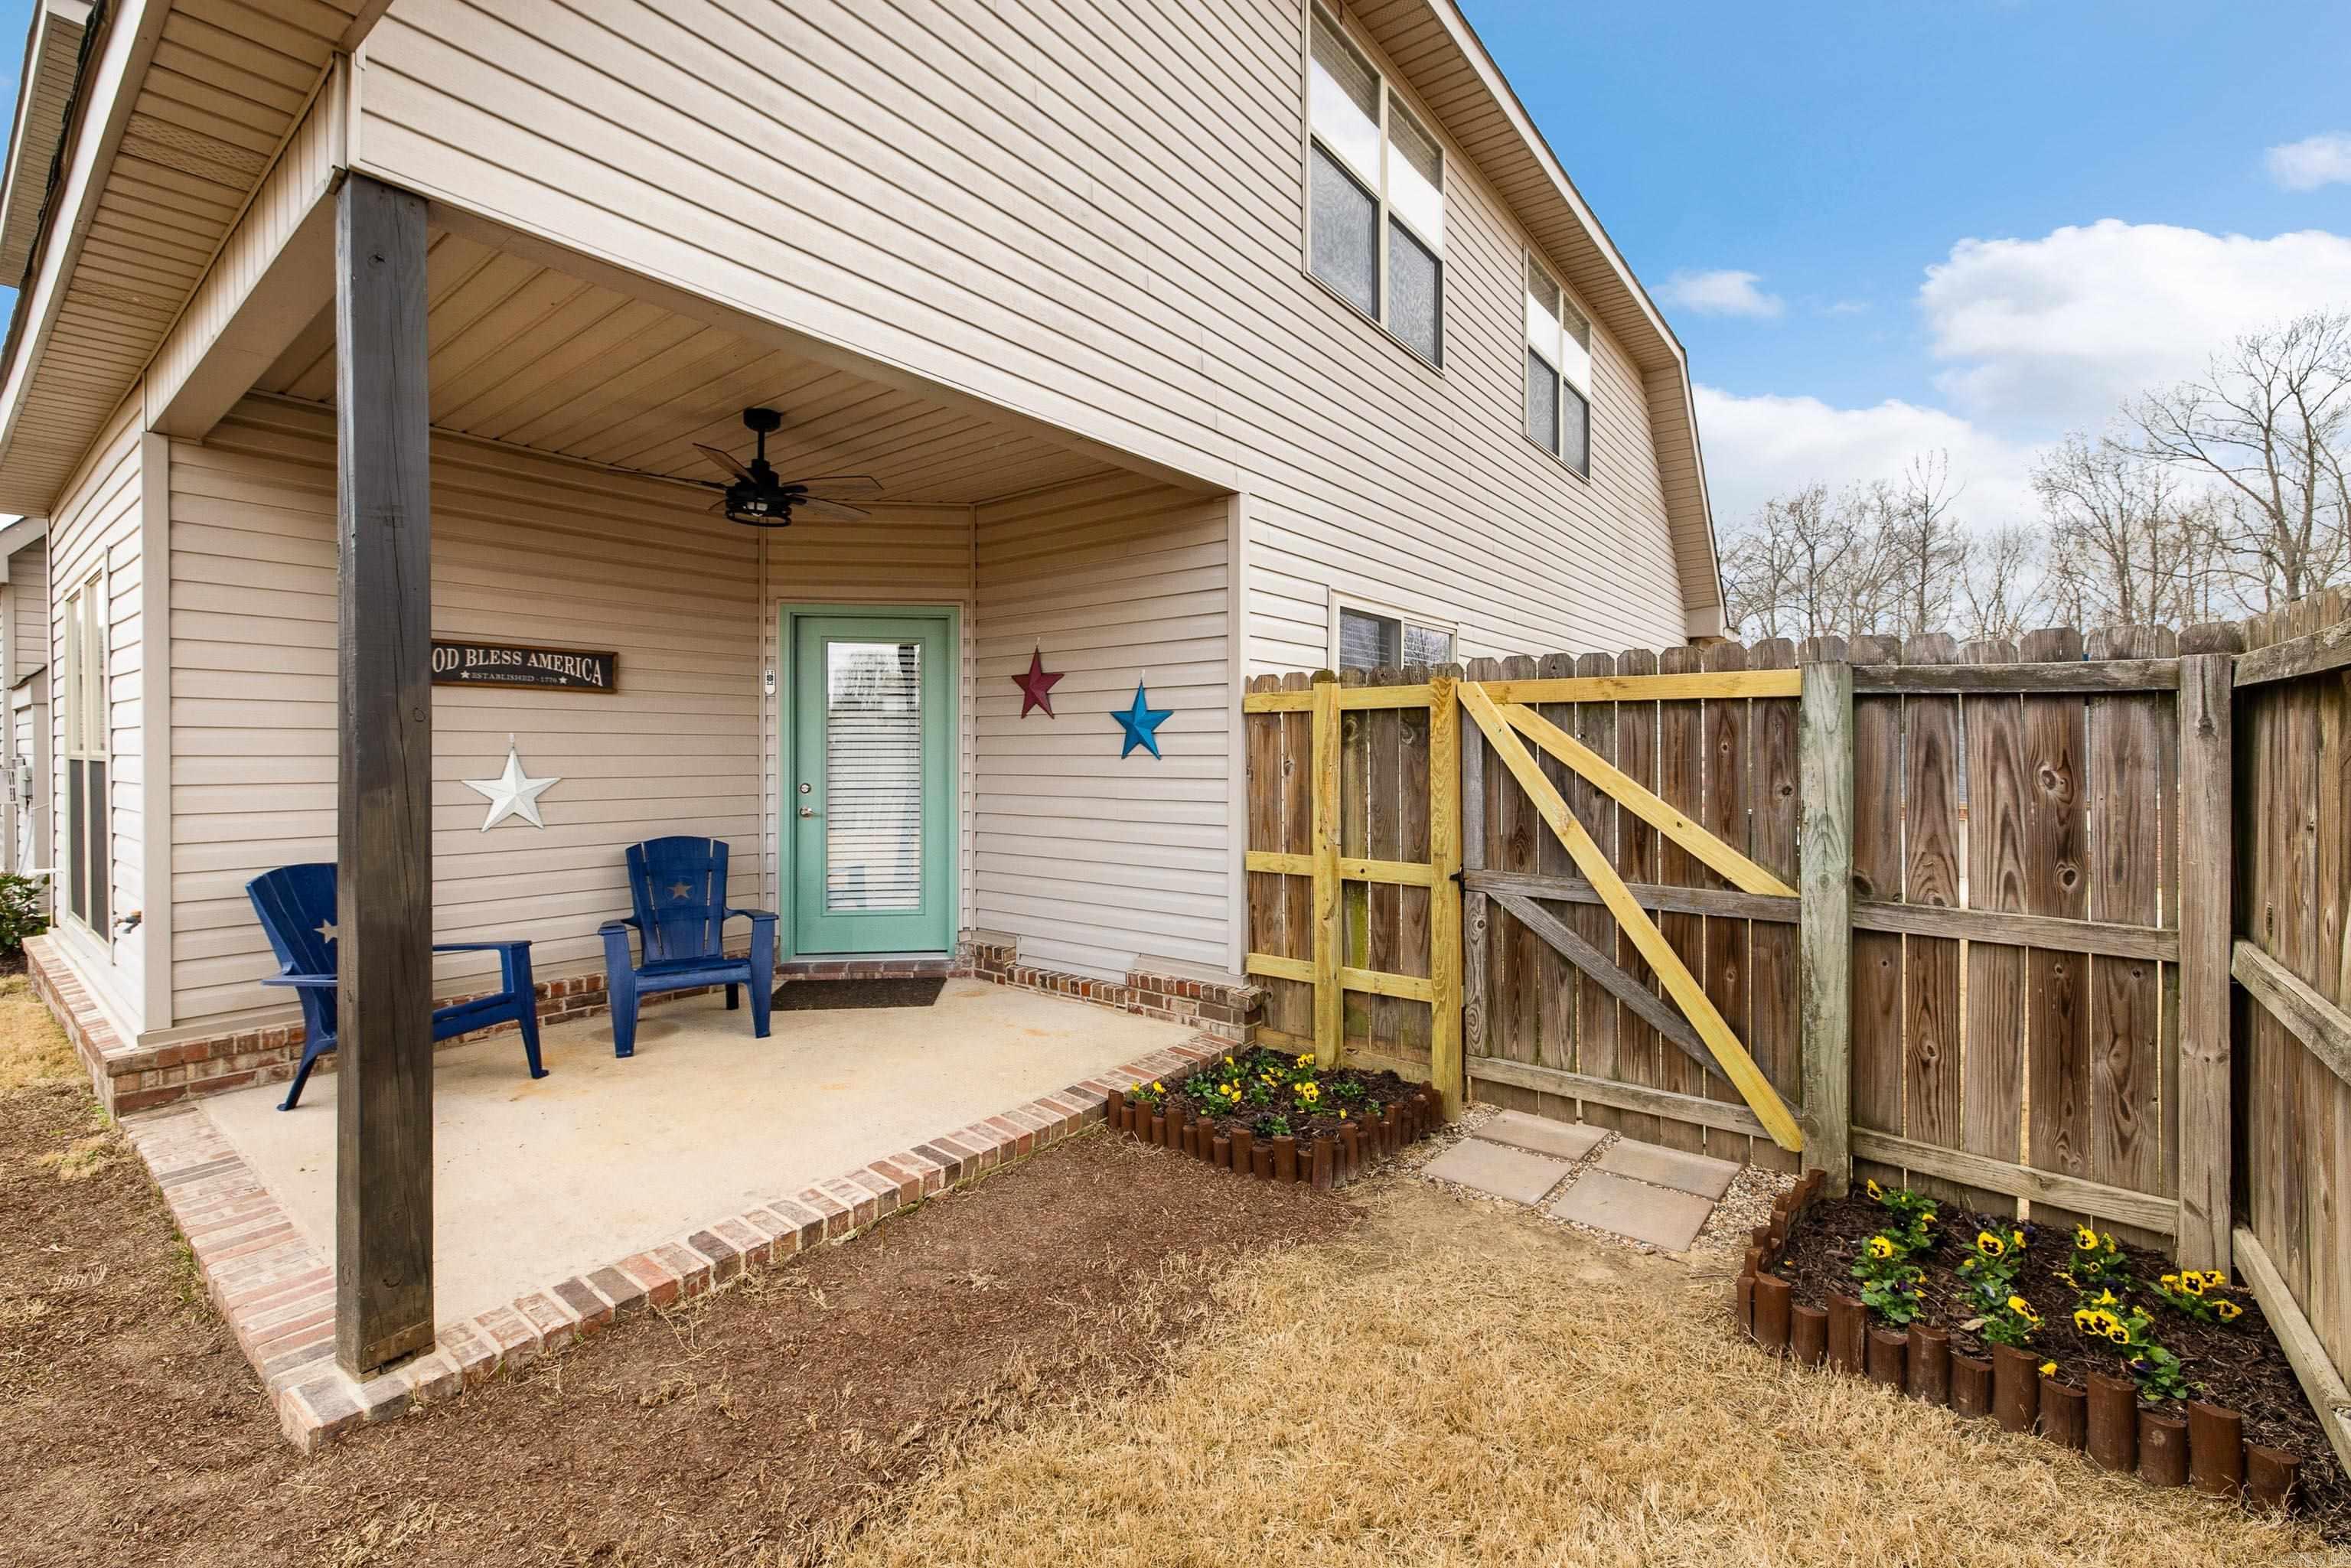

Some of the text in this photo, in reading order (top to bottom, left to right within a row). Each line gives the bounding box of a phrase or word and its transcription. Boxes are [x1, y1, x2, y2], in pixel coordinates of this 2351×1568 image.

[432, 648, 603, 686] OD BLESS AMERICA
[471, 673, 534, 681] ESTABLISHED
